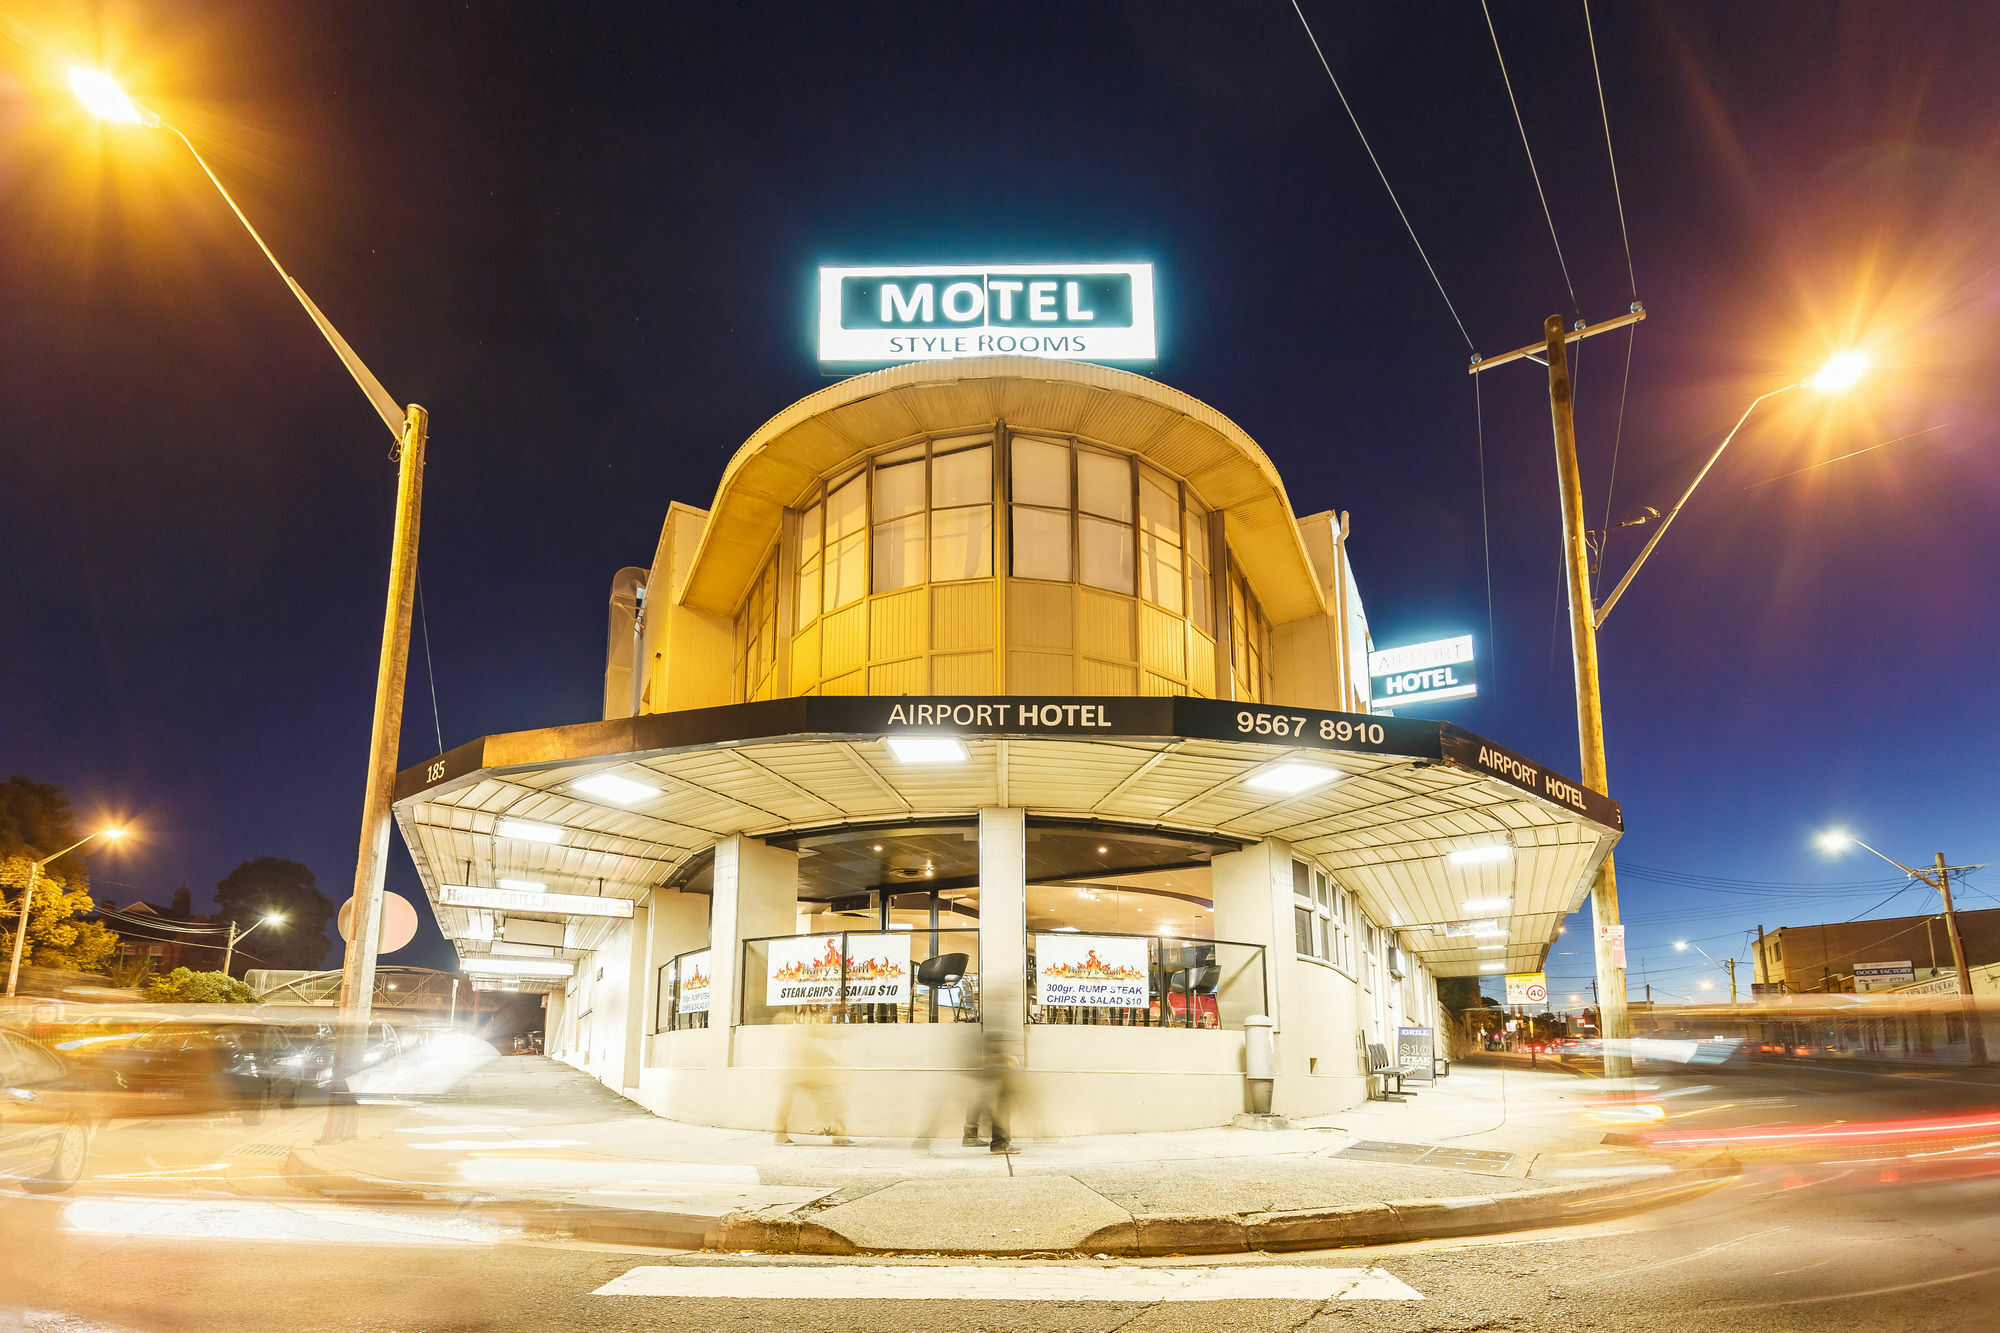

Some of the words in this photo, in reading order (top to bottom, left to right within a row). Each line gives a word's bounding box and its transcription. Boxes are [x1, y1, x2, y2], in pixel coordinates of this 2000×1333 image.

[881, 281, 1094, 323] MOTEL
[889, 336, 967, 353] STYLE
[978, 334, 1087, 353] ROOMS
[1386, 667, 1458, 695] HOTEL
[887, 703, 1011, 727] AIRPORT
[1019, 704, 1112, 727] HOTEL
[1236, 711, 1307, 738] 9567
[1319, 719, 1385, 745] 8910
[426, 760, 446, 784] 185
[1478, 745, 1538, 788] AIRPORT
[1545, 775, 1587, 811] HOTEL
[844, 985, 877, 997] SALAD
[877, 984, 899, 997] $10
[1046, 994, 1077, 1004] CHIPS
[1079, 995, 1087, 1004] &
[1089, 996, 1123, 1005] SALAD
[1125, 997, 1142, 1006] $10
[1078, 984, 1108, 994] RUMP
[1109, 985, 1143, 995] STEAK
[1530, 989, 1544, 997] 40
